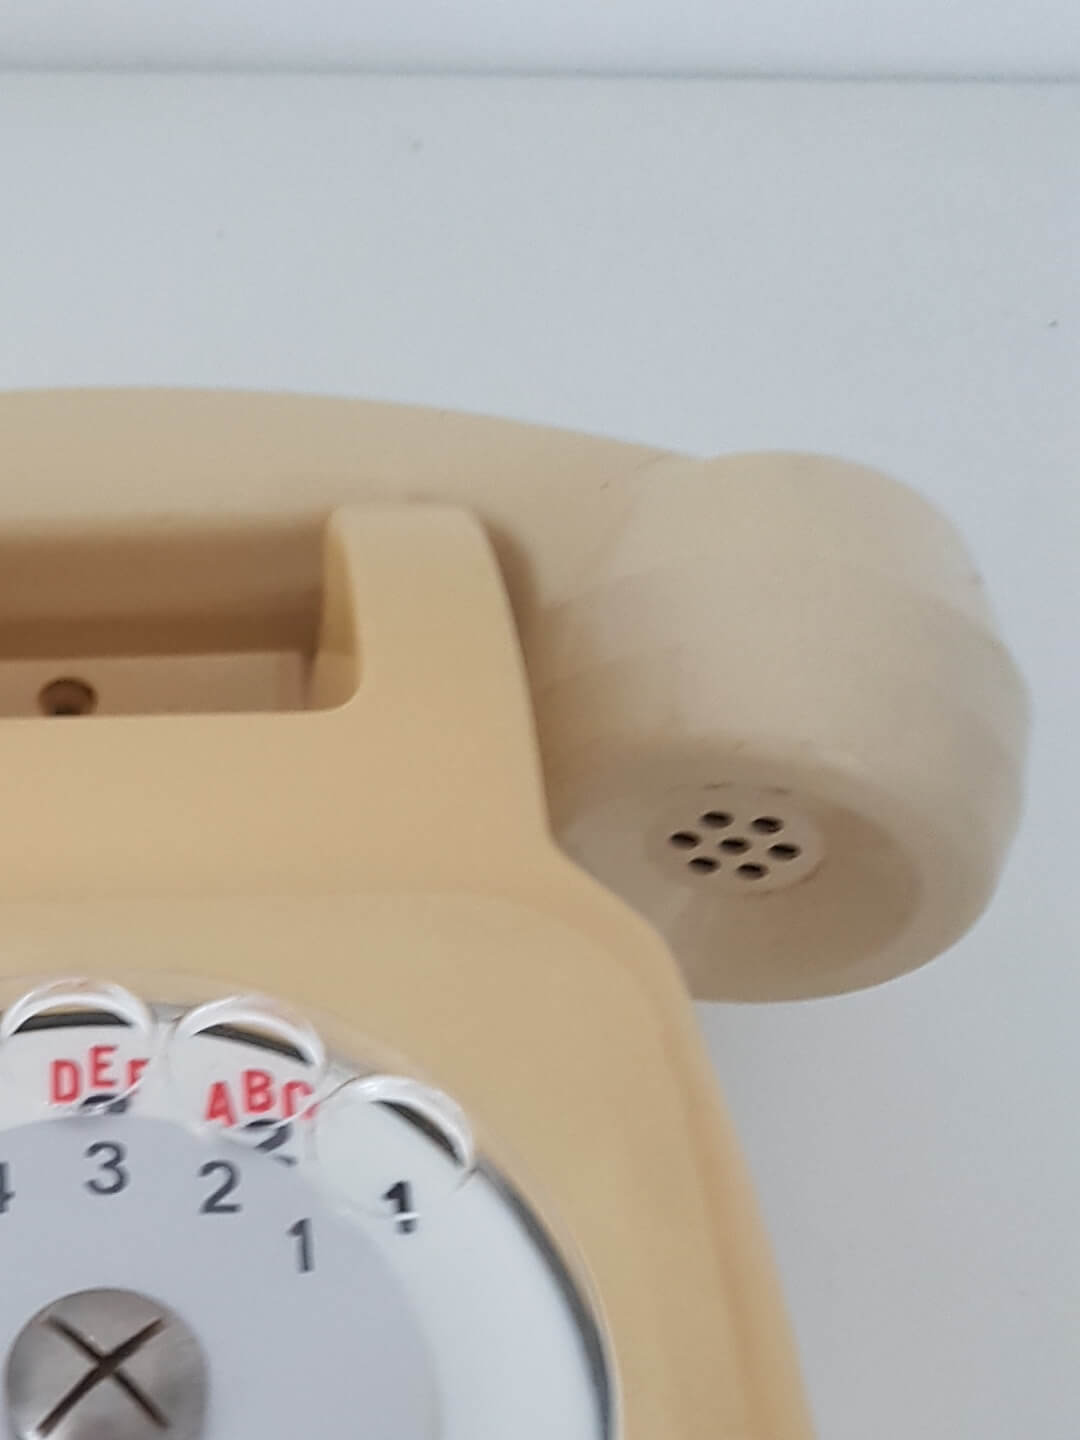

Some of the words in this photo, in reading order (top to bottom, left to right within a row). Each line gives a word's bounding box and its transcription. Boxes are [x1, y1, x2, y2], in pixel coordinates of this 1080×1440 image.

[85, 1143, 128, 1195] 3
[199, 1160, 241, 1214] 2
[286, 1218, 314, 1272] 1
